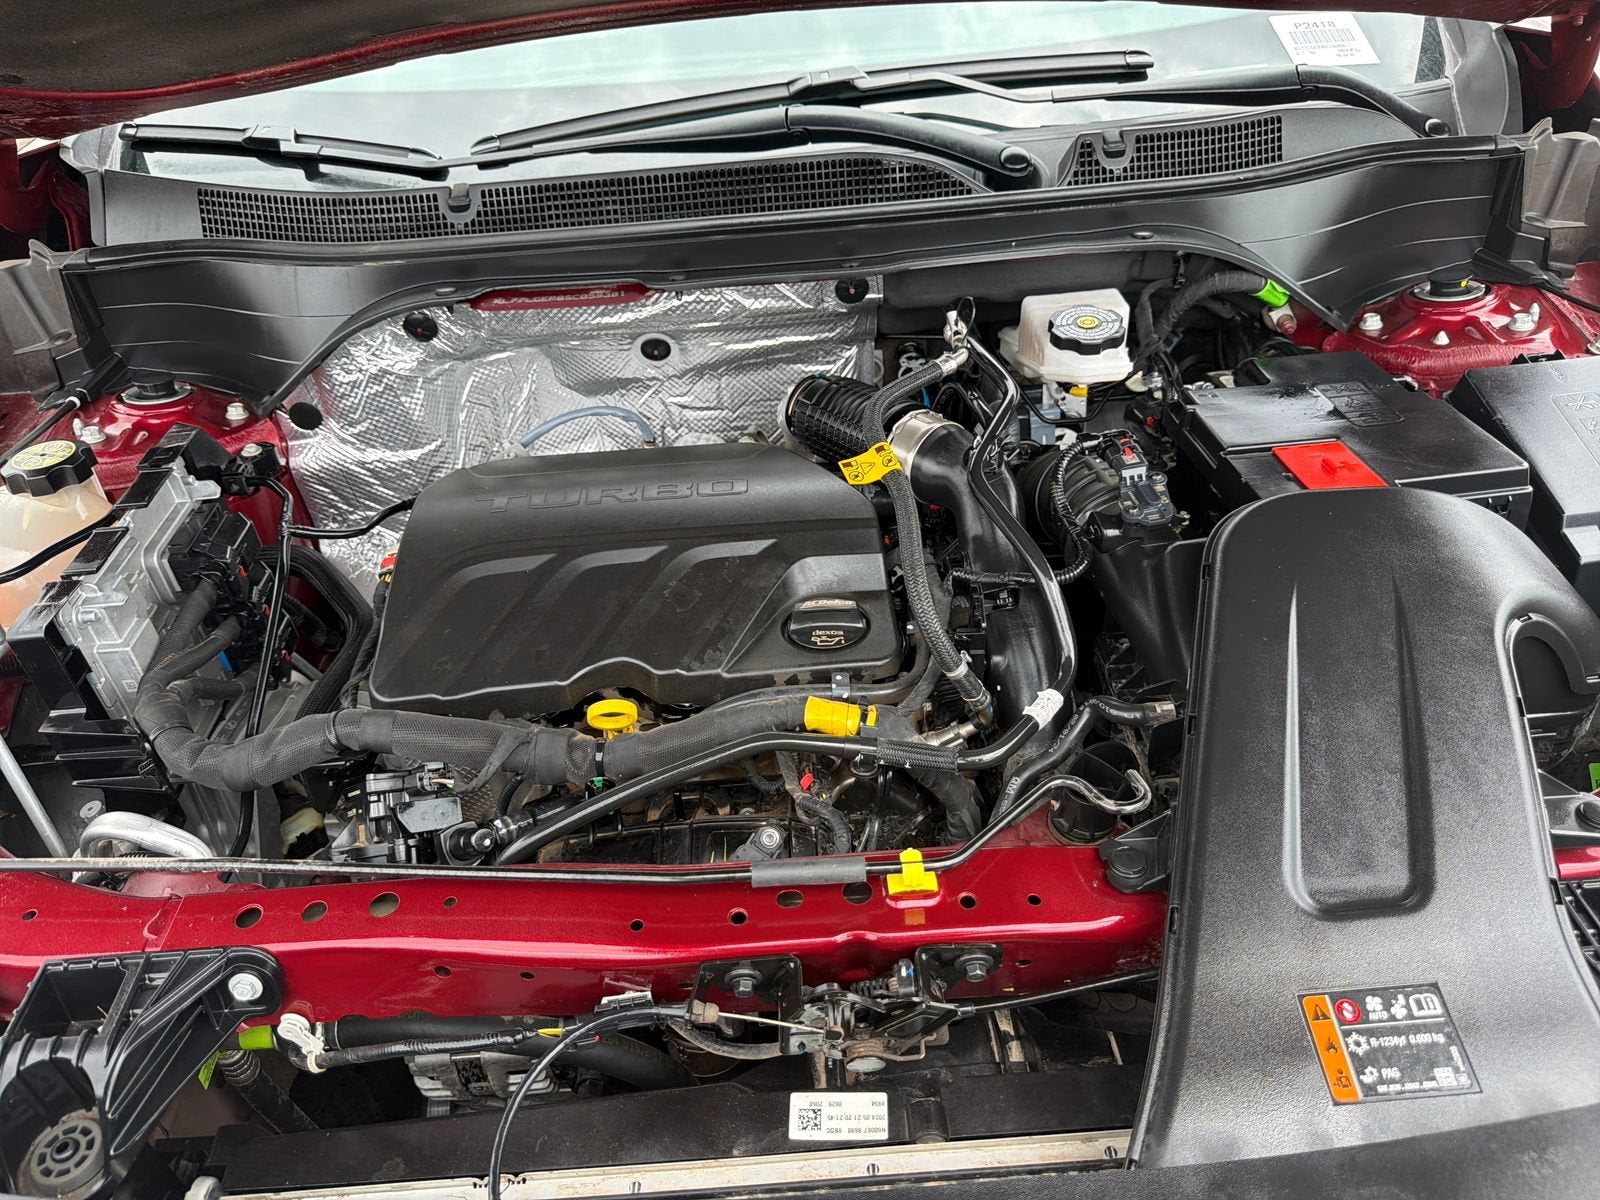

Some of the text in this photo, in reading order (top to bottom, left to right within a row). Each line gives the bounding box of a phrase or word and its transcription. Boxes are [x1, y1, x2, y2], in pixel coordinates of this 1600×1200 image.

[1293, 20, 1337, 30] P2418
[477, 479, 749, 513] TURBO
[1368, 1011, 1388, 1020] AUTO
[1432, 1033, 1446, 1044] kg
[1380, 1067, 1401, 1080] PAG
